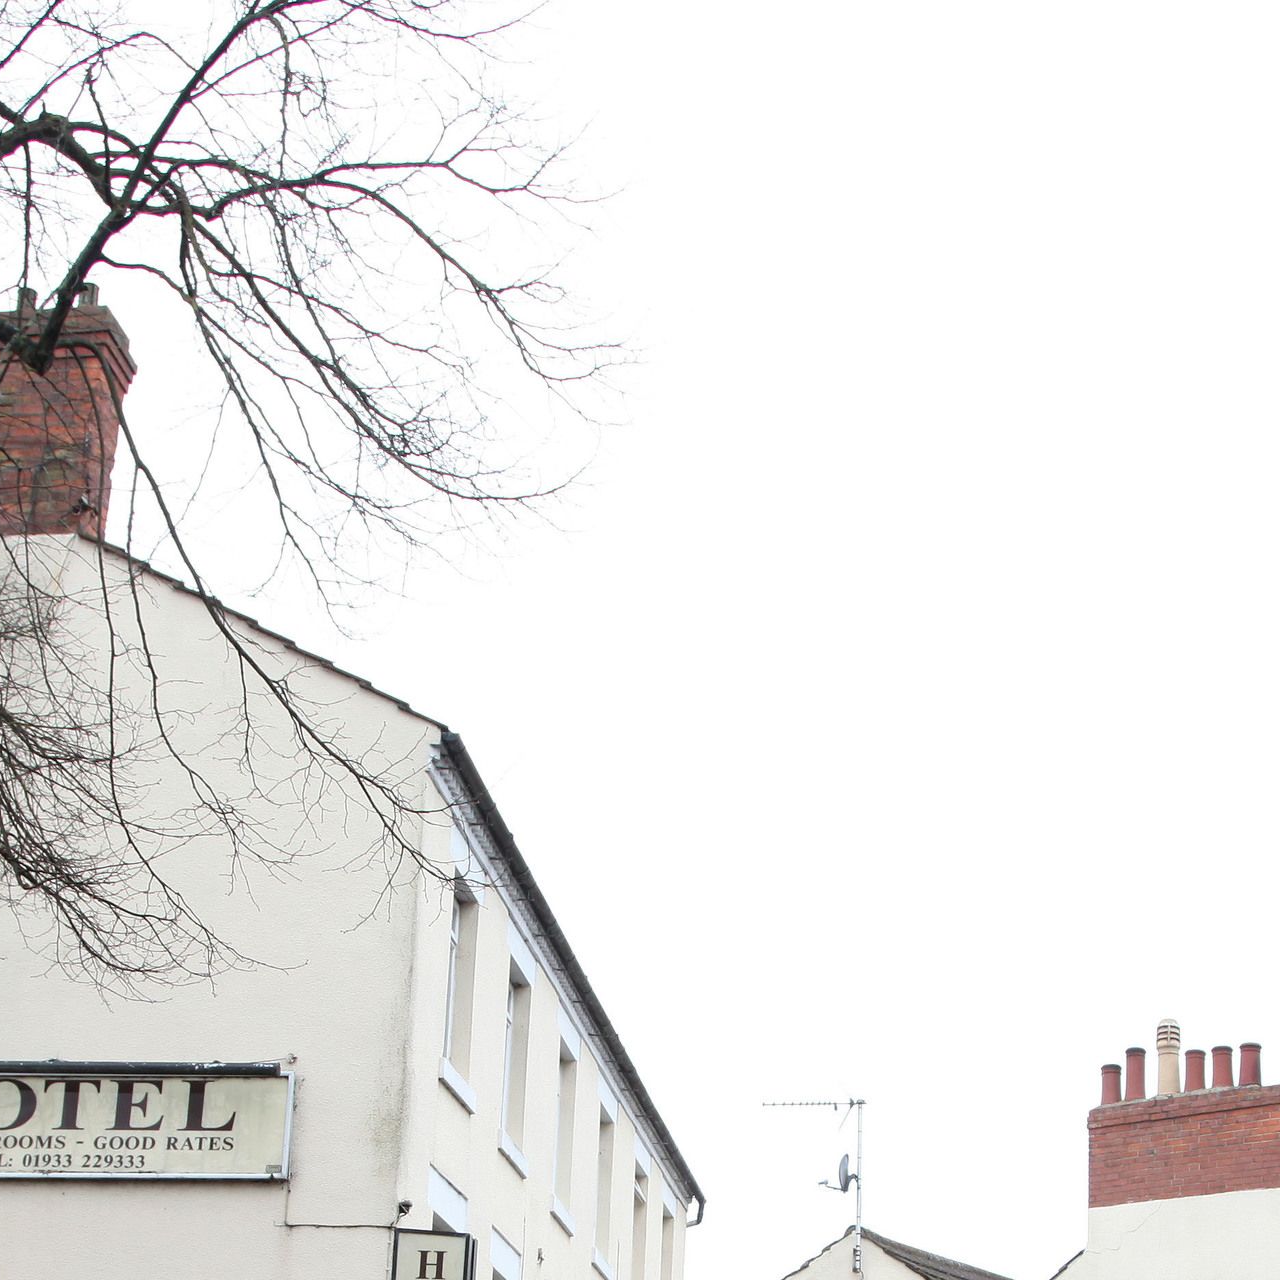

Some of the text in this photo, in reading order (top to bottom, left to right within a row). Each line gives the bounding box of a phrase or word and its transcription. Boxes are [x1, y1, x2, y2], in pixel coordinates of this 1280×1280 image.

[93, 1136, 156, 1151] GOOD
[165, 1136, 235, 1152] RATES
[21, 1154, 73, 1168] 01933
[81, 1155, 145, 1169] 229333
